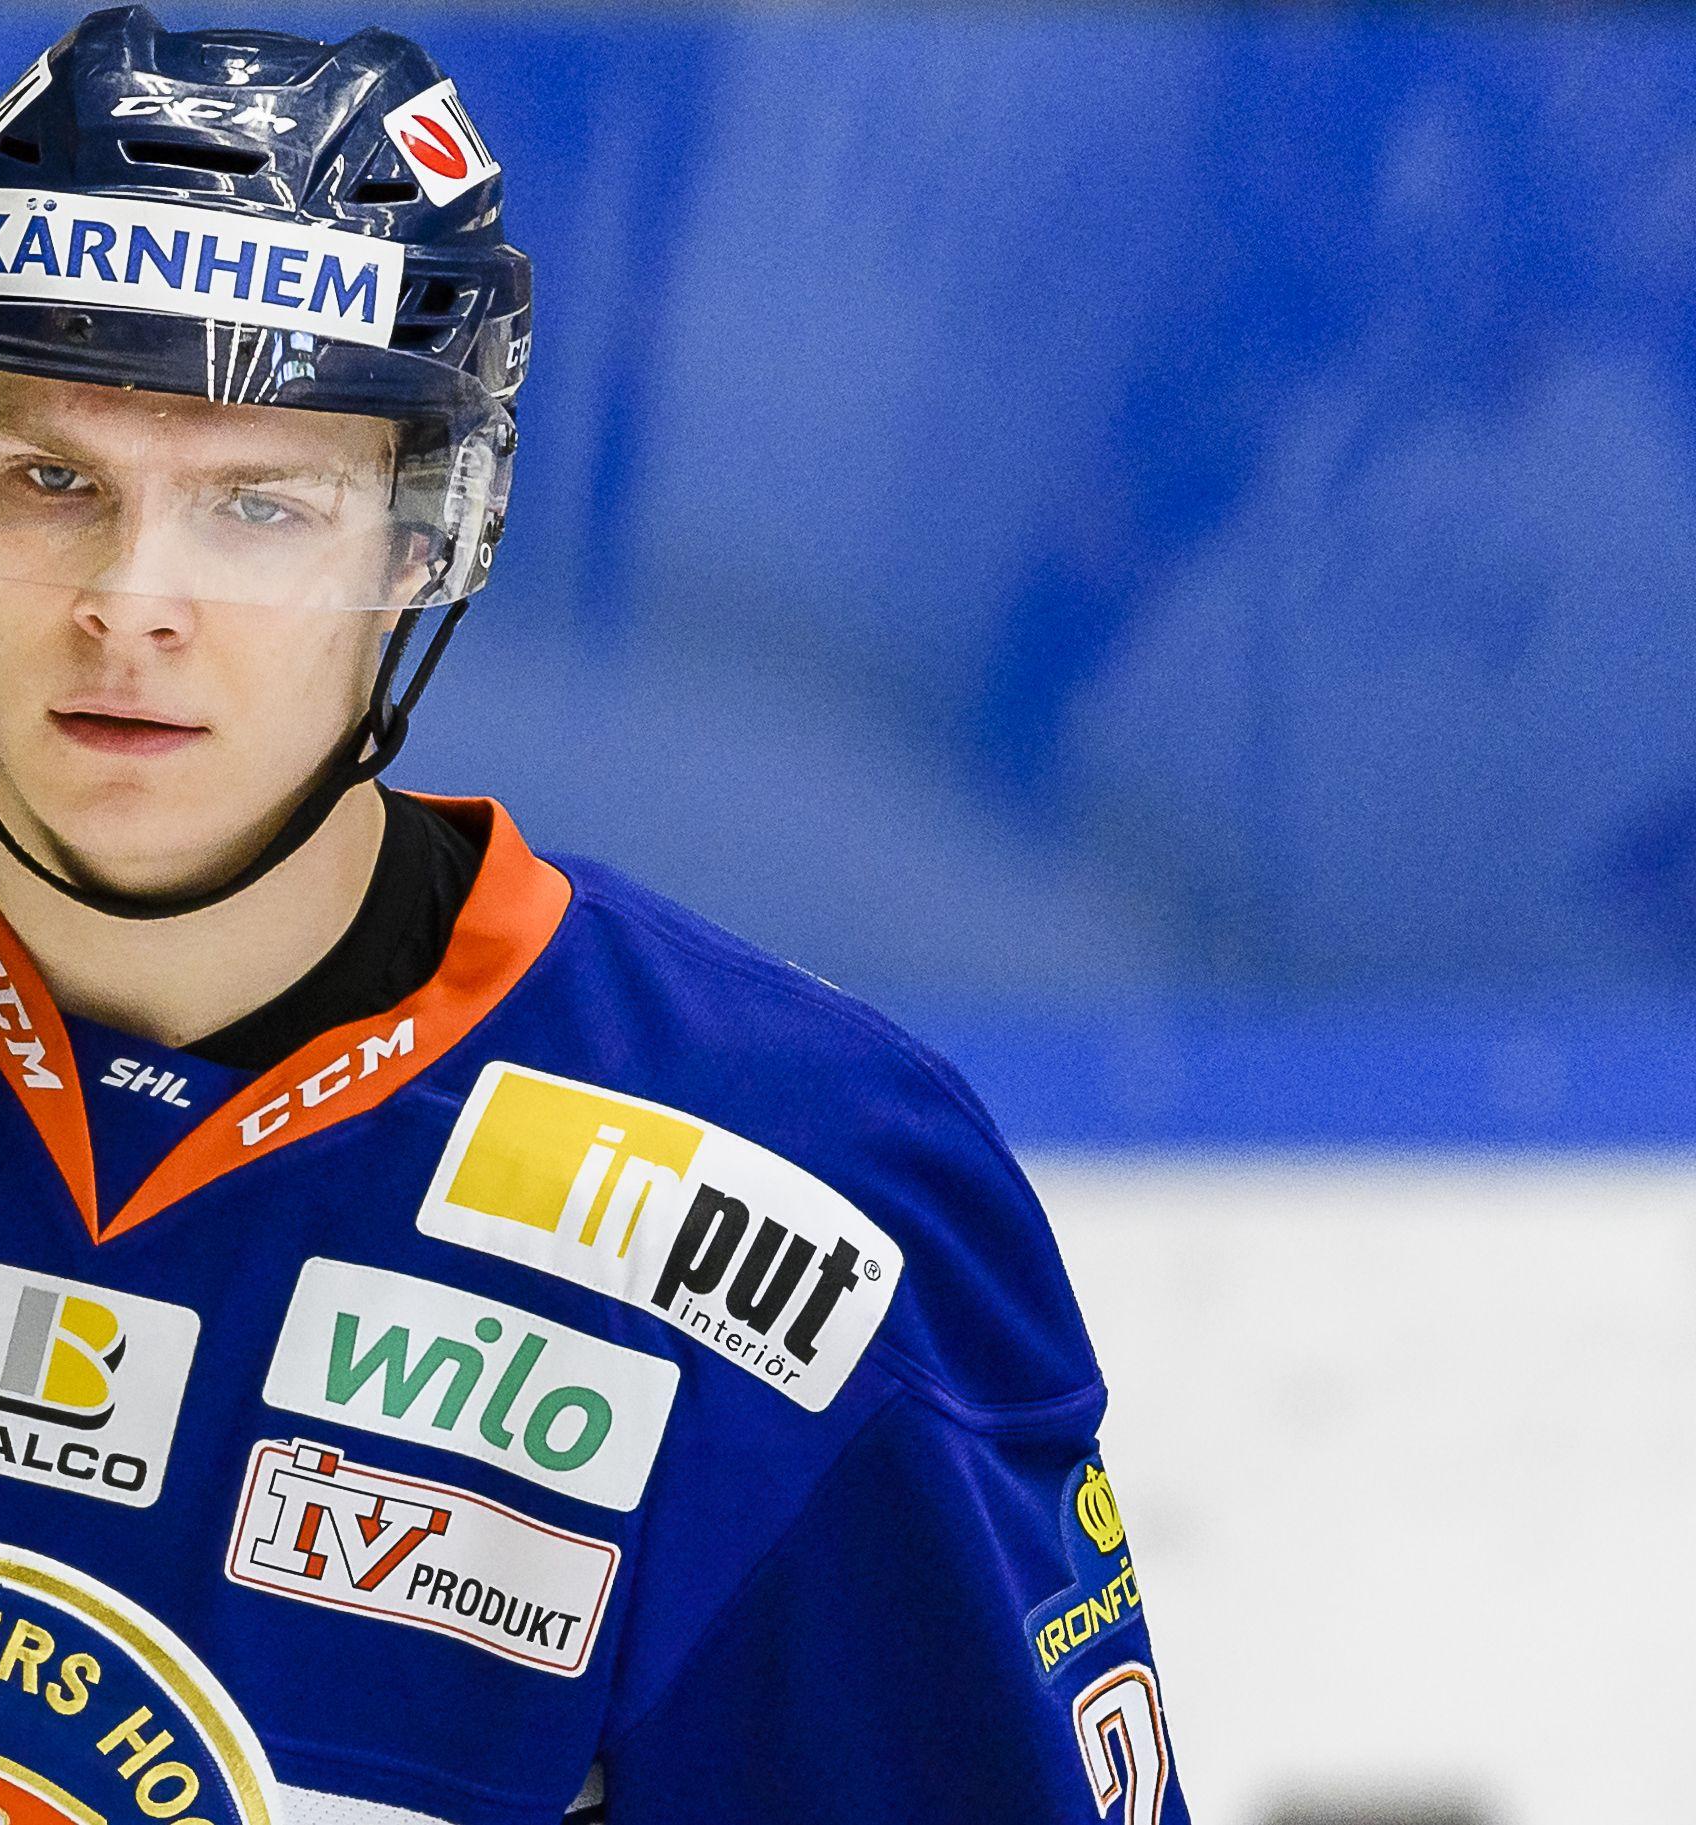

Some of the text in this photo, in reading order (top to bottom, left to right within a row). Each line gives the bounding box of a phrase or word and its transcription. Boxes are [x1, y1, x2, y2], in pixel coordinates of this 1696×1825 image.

[100, 1057, 192, 1108] SHL
[236, 1018, 414, 1146] CCM
[679, 1297, 801, 1387] interiör
[325, 1311, 613, 1472] wilo
[406, 1563, 582, 1652] PRODUKT
